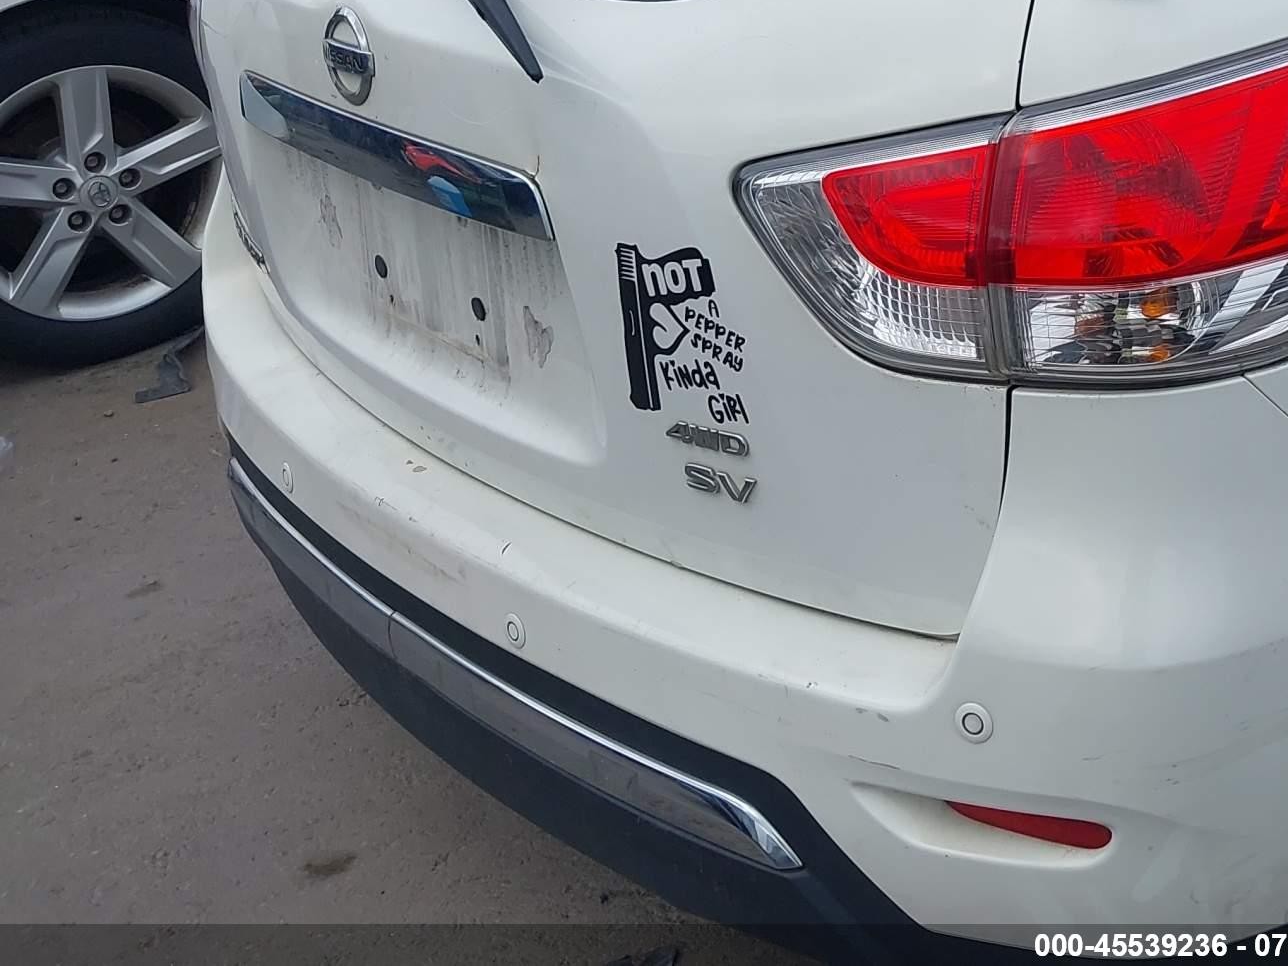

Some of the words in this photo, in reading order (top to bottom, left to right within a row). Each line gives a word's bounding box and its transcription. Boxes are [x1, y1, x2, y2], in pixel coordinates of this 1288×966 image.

[708, 299, 720, 318] A
[684, 306, 746, 353] PEPPER
[691, 333, 744, 372] SPRAY
[666, 421, 750, 457] 4WD
[685, 462, 758, 504] SV
